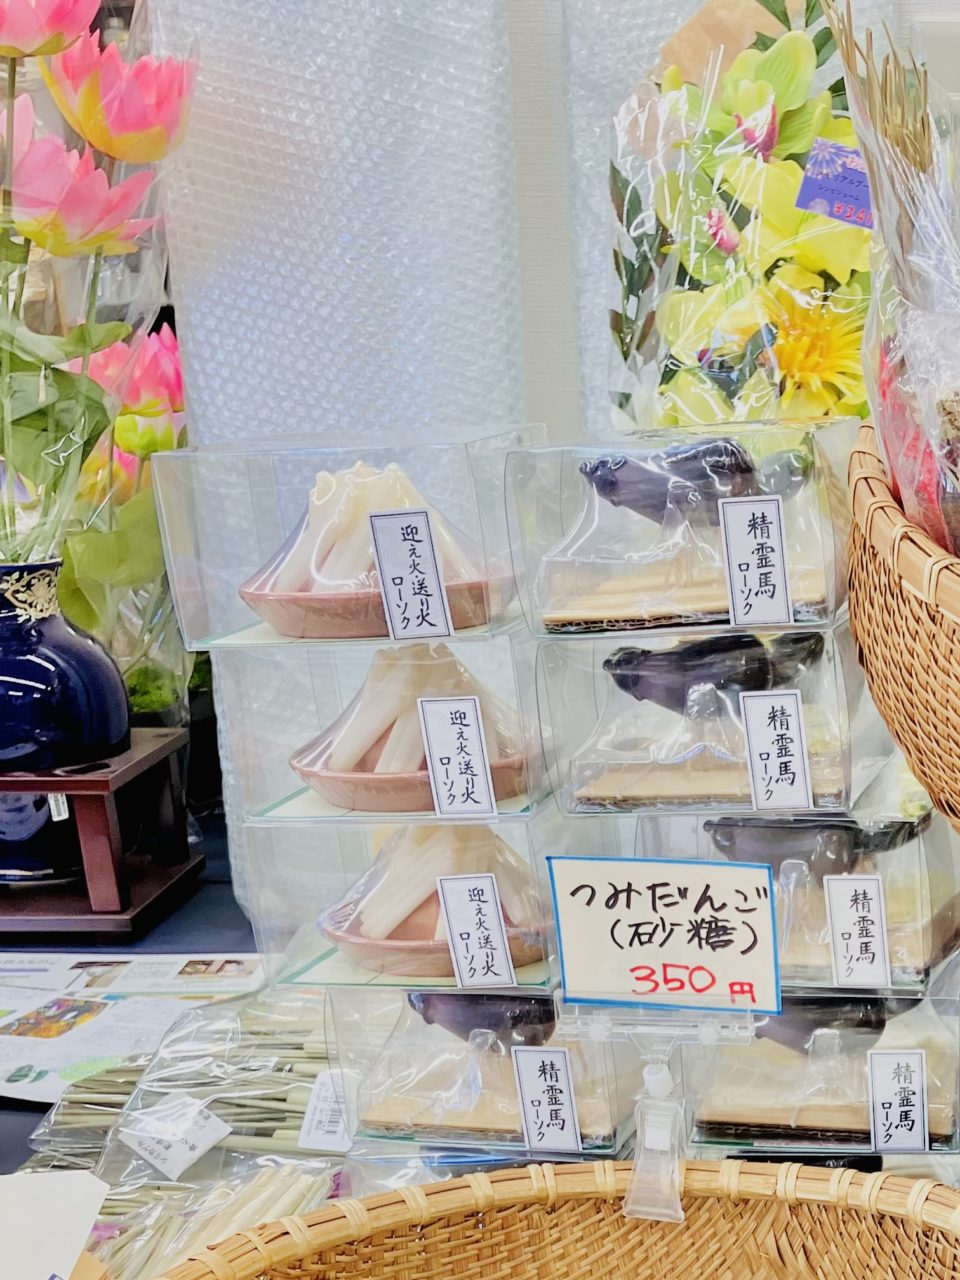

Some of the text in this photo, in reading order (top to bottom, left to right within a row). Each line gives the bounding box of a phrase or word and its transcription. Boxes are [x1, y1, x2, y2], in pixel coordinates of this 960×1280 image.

[747, 511, 776, 600] 精霊馬
[391, 576, 410, 631] ローソク
[738, 562, 753, 616] ローソク
[767, 705, 797, 787] 精霊馬
[440, 756, 457, 806] ローソク
[759, 752, 774, 802] ローソク
[569, 881, 769, 915] つみだんご
[849, 888, 876, 966] 精霊馬
[459, 931, 477, 979] ローソク
[841, 931, 855, 979] ローソク
[531, 1099, 546, 1143] ローソク
[538, 1060, 567, 1132] 精霊馬
[892, 1062, 918, 1132] 精霊馬
[881, 1101, 894, 1144] ローソク
